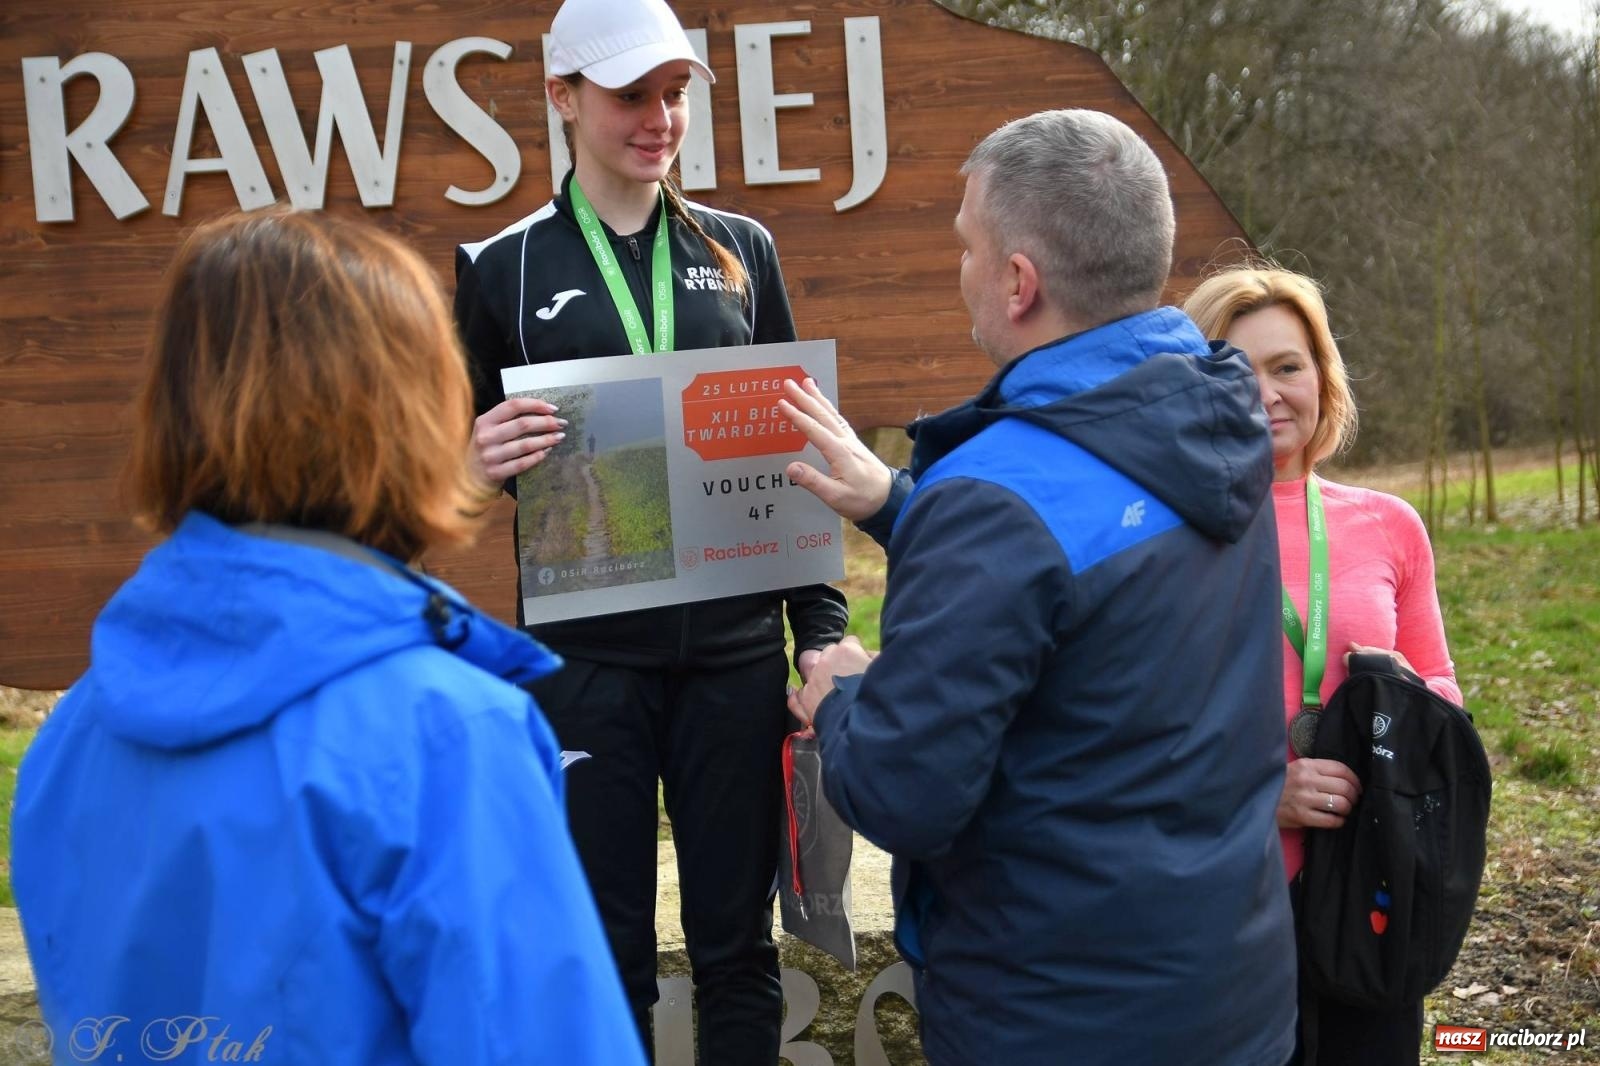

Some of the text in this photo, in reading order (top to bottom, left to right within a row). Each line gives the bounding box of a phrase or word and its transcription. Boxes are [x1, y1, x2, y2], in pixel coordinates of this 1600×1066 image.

[703, 379, 780, 396] 25 LUTEG
[711, 406, 779, 424] XII BIE
[703, 532, 832, 562] Racibórz OSiR
